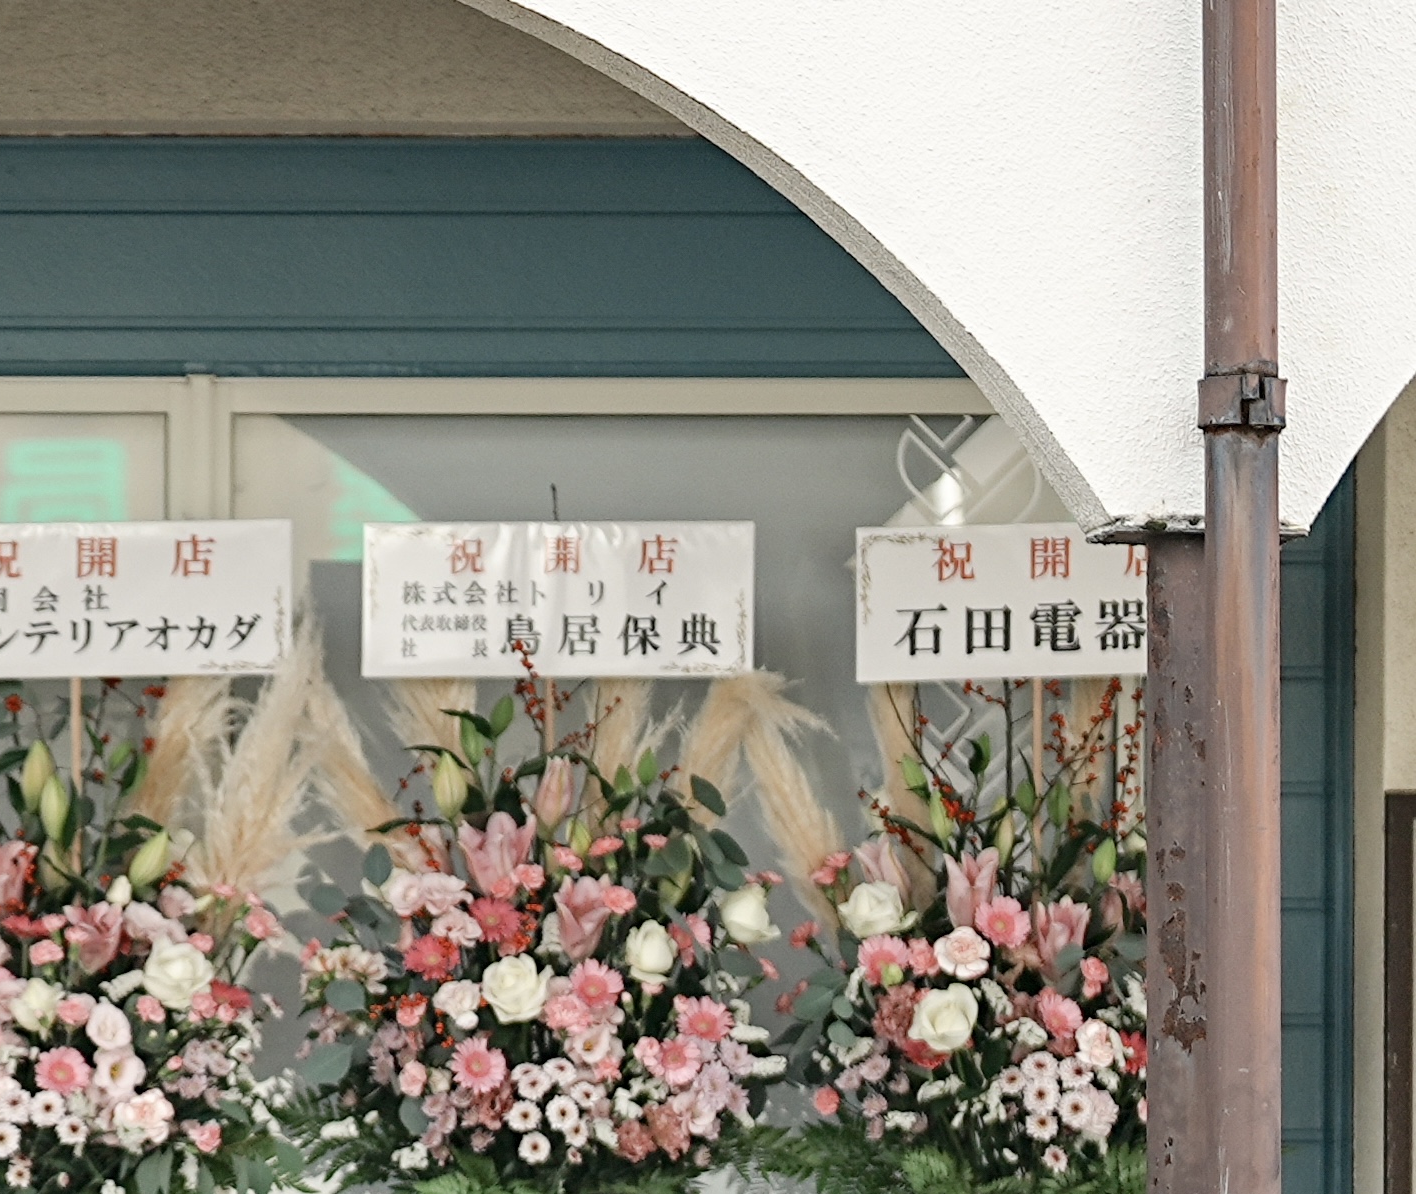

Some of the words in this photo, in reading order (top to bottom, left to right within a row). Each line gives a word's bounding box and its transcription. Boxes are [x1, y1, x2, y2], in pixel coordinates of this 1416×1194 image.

[499, 612, 722, 657] 鳥居保典
[894, 598, 1147, 657] 石田電器
